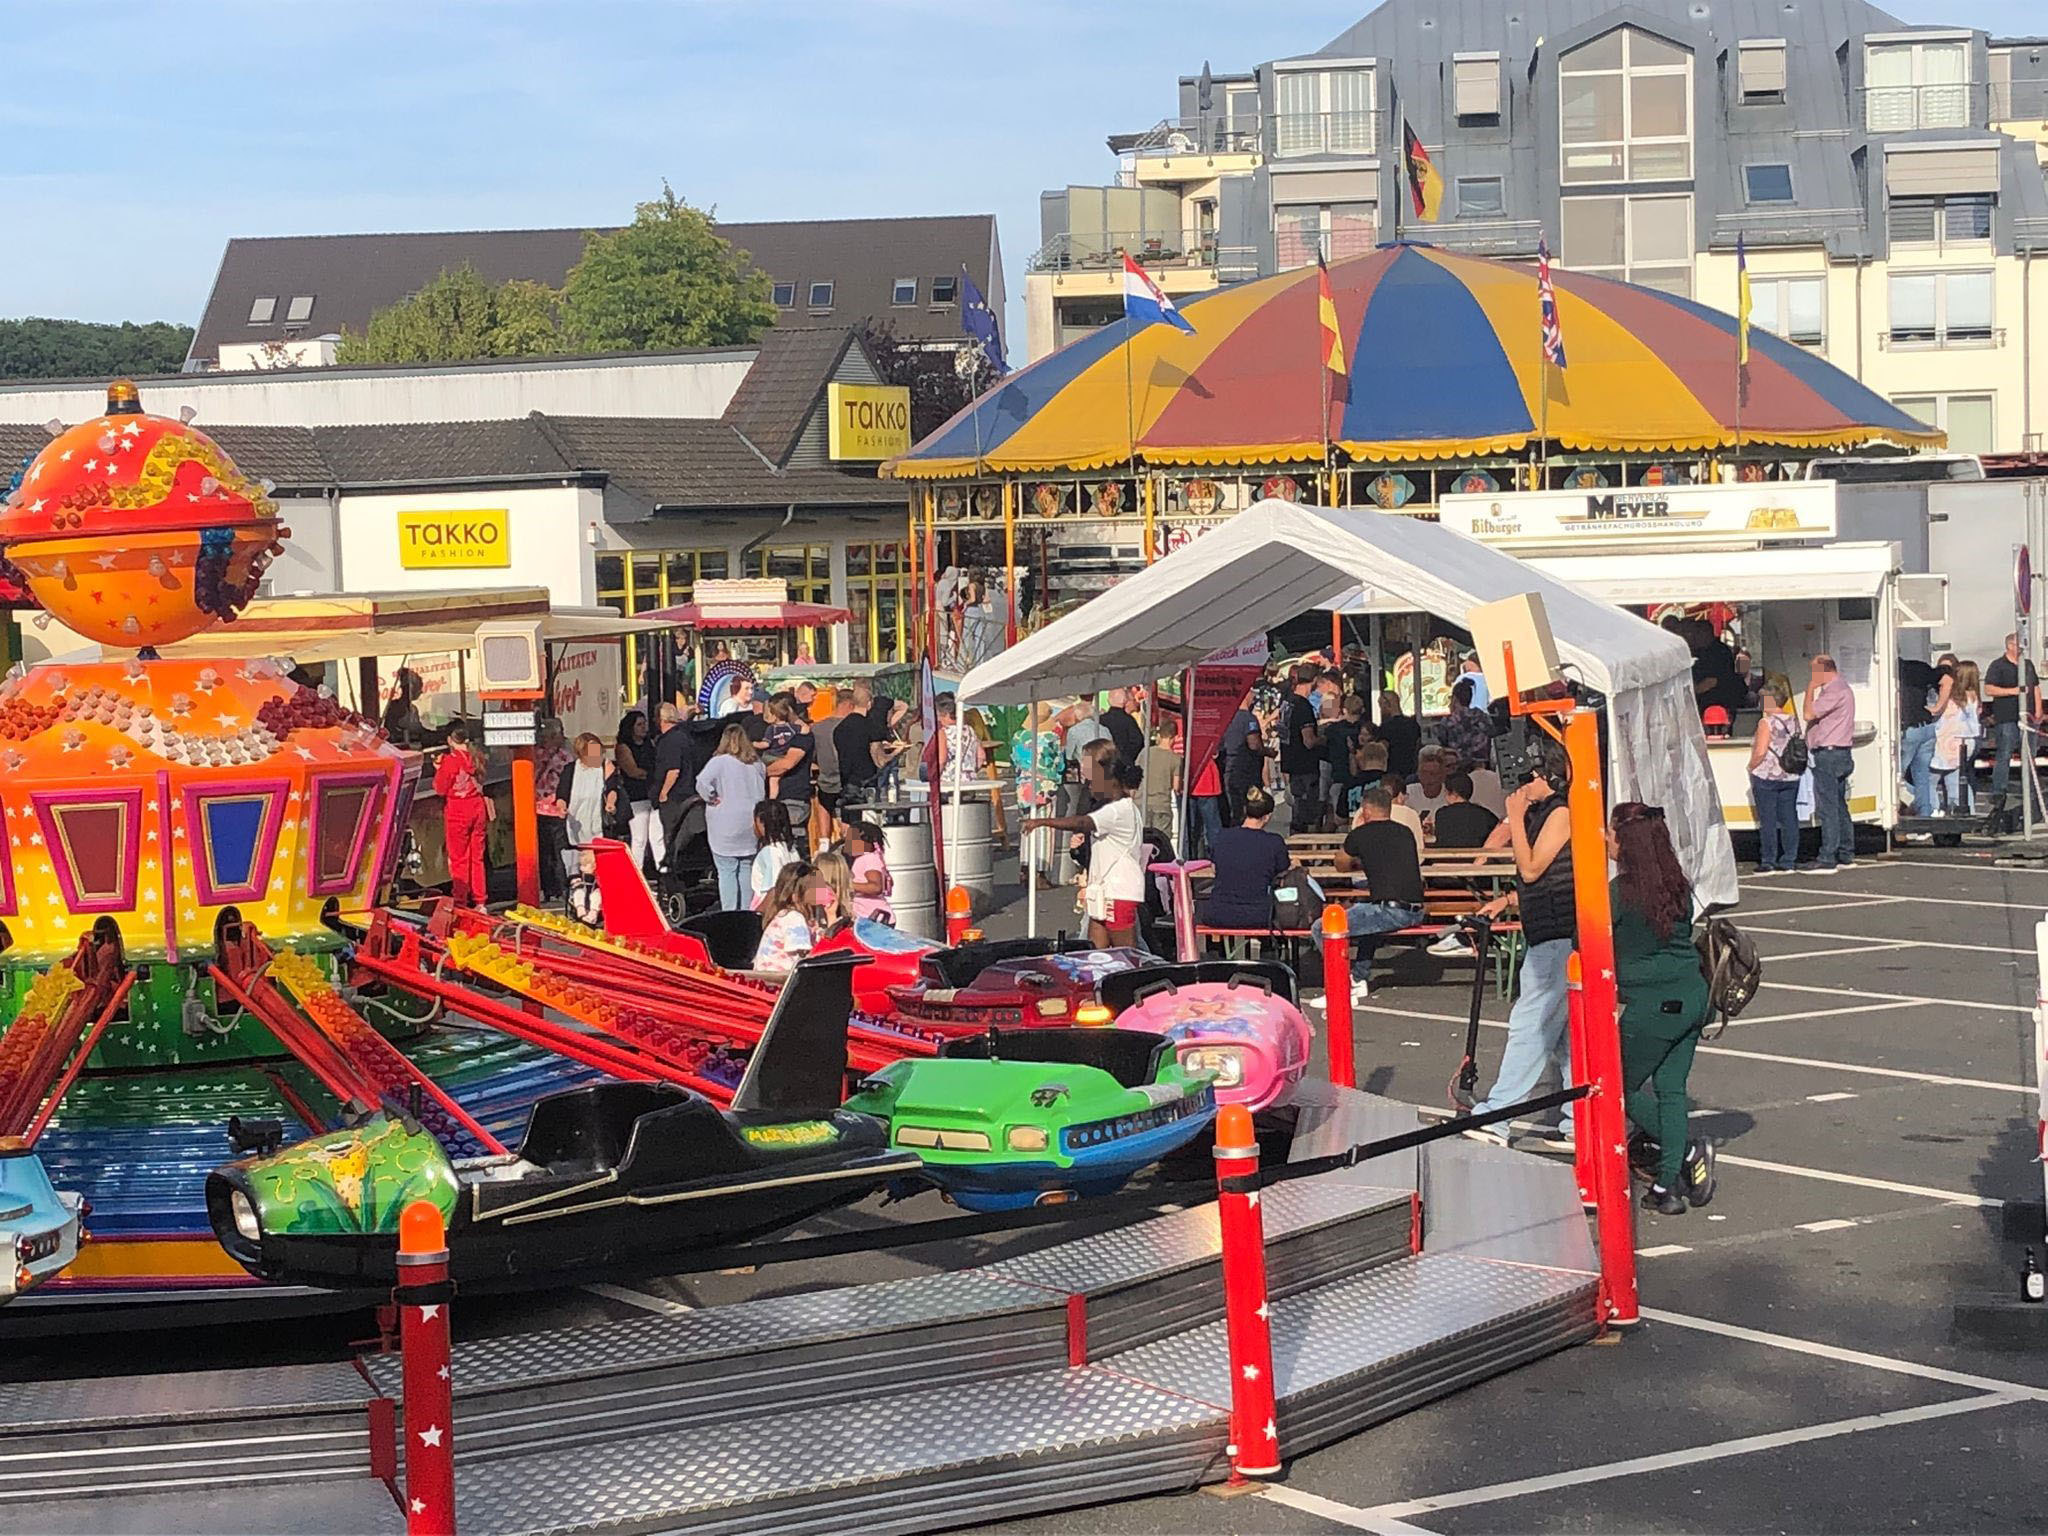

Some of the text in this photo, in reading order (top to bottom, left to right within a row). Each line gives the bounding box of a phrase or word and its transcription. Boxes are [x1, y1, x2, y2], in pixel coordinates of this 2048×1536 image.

[857, 435, 901, 447] FASHION
[1587, 495, 1670, 520] MEYER
[1471, 519, 1522, 535] Bitburger
[421, 548, 485, 558] FASHION
